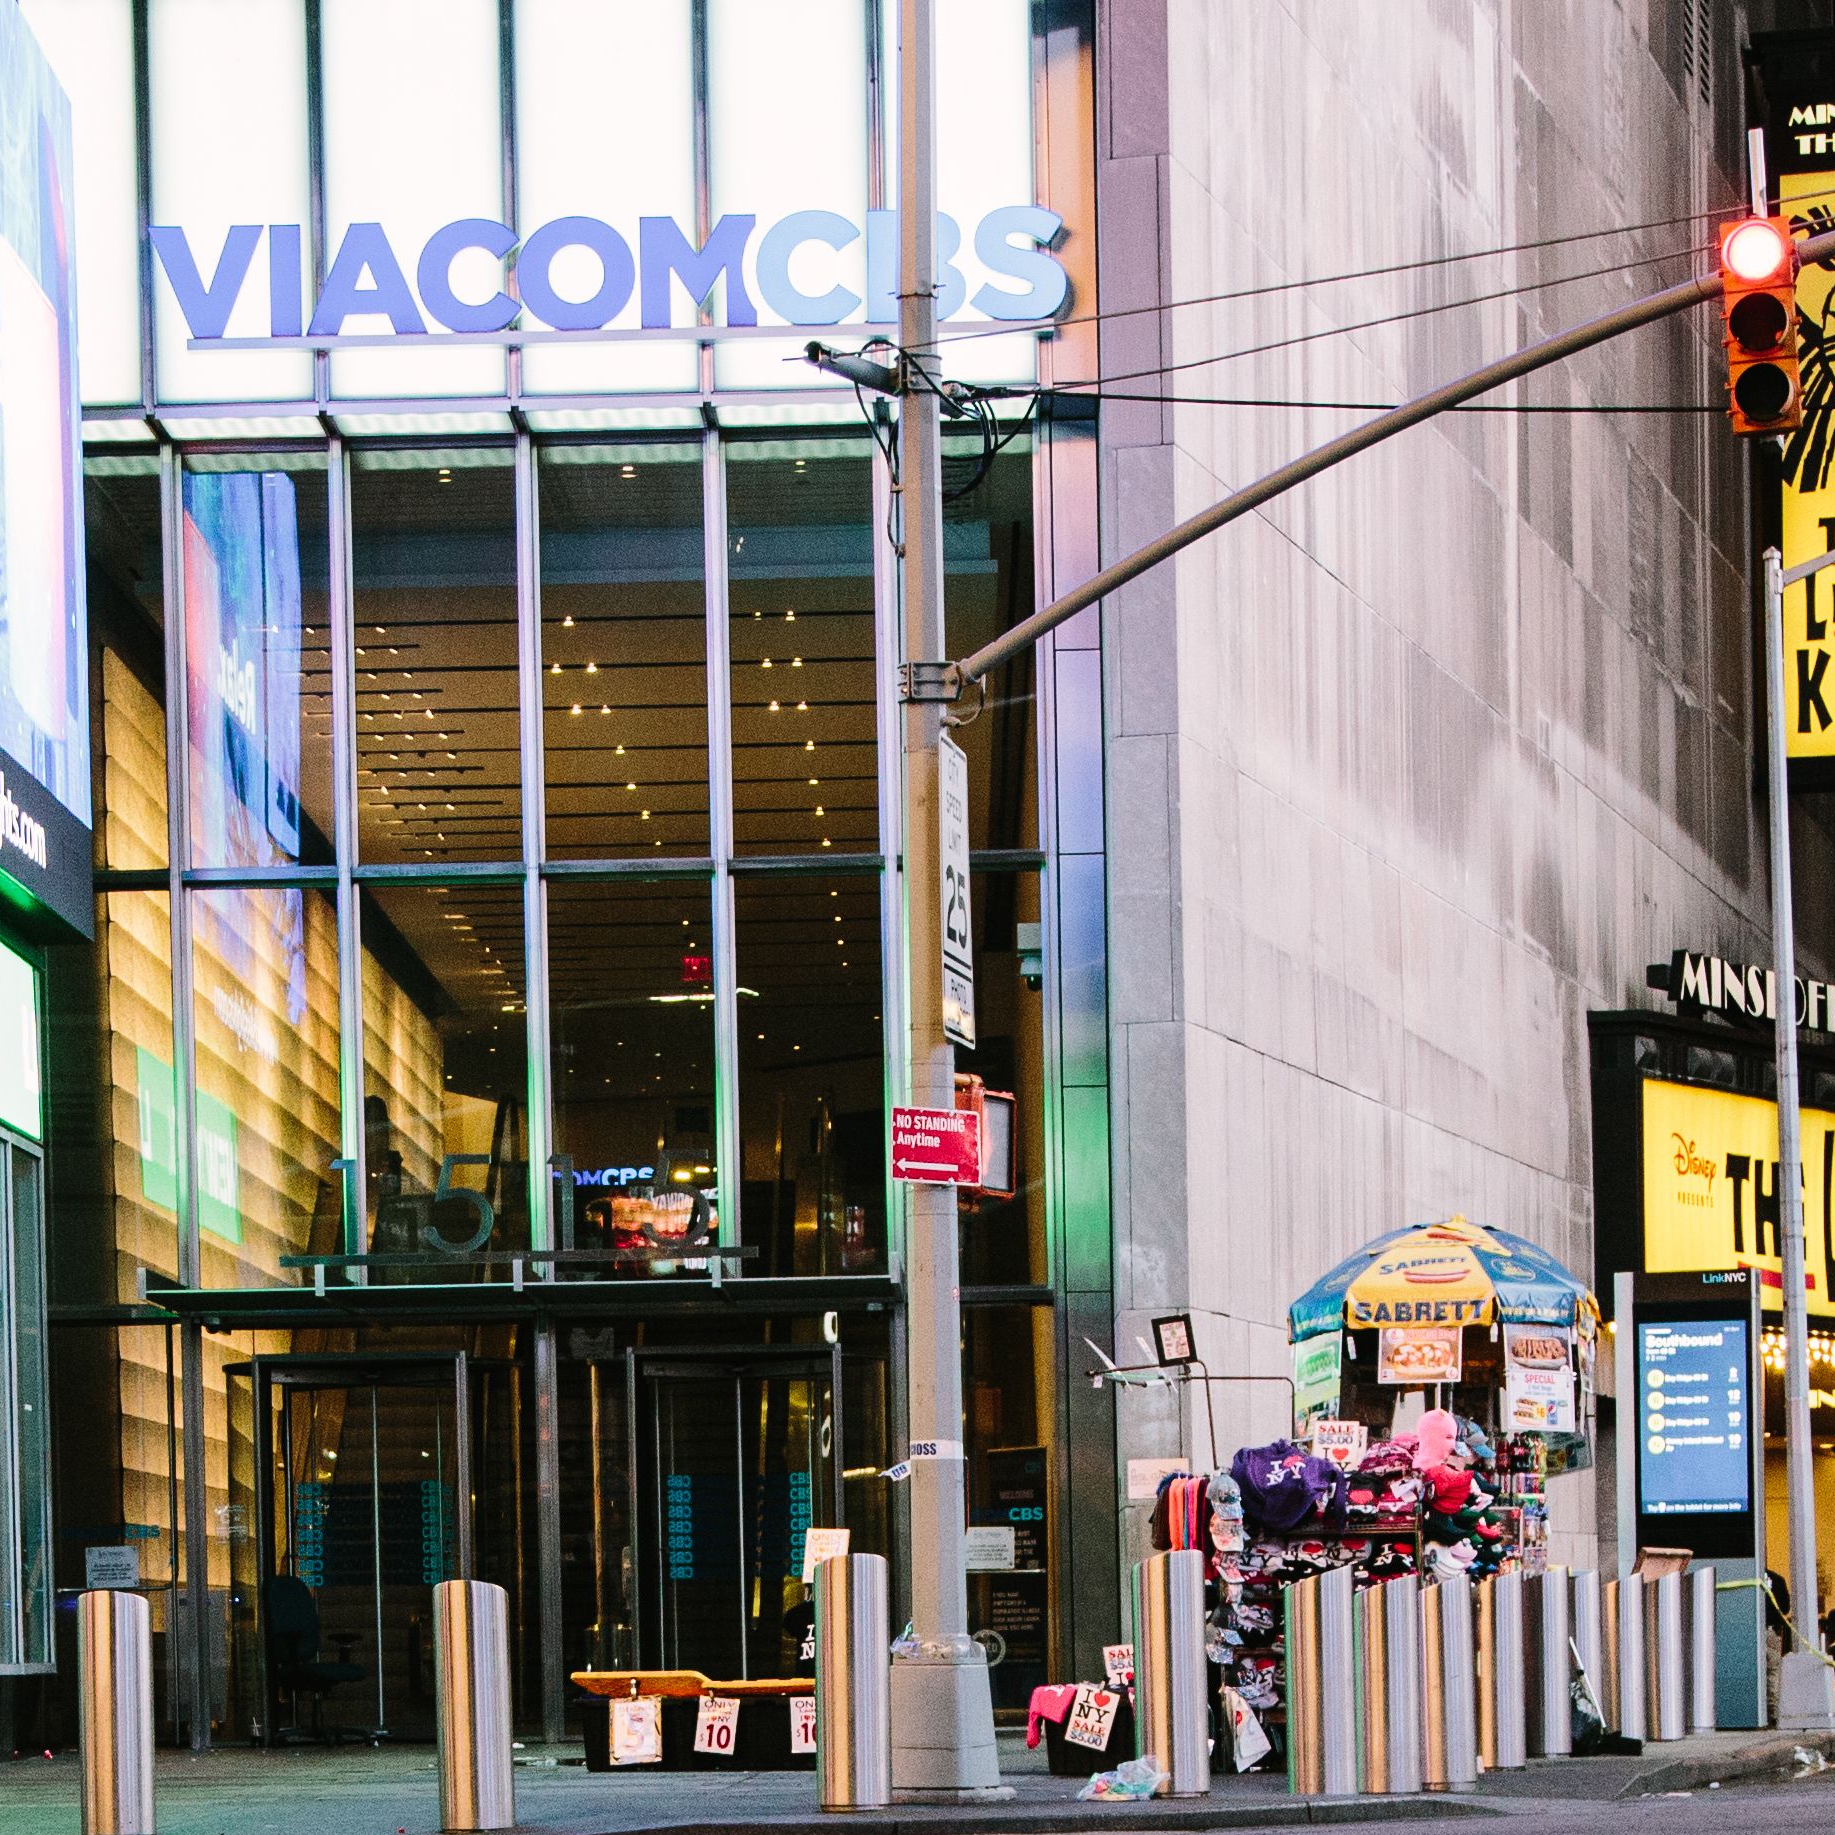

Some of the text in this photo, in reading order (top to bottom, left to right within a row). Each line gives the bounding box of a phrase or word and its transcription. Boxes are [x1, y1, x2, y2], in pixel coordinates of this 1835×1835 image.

[148, 204, 1068, 338] VIACOMCBS
[945, 863, 967, 950] 25
[897, 1114, 966, 1133] NO STANDING
[897, 1131, 941, 1149] Anytime
[1677, 1191, 1715, 1208] PRESENTS
[1379, 1255, 1468, 1275] SABRETT
[1702, 1271, 1747, 1284] LinkNYC
[1355, 1300, 1486, 1323] SABRETT
[1645, 1332, 1723, 1349] Southbound
[1523, 1374, 1557, 1385] SPECIAL
[1318, 1424, 1355, 1435] SALE
[1318, 1434, 1355, 1445] $5.00
[1322, 1447, 1329, 1459] I
[1008, 1506, 1044, 1521] CBS
[1108, 1648, 1134, 1659] SAL
[1083, 1688, 1091, 1704] I
[704, 1699, 736, 1710] ONLY
[1076, 1702, 1110, 1724] NY
[1073, 1719, 1107, 1735] SALE
[1069, 1730, 1103, 1747] $5.00
